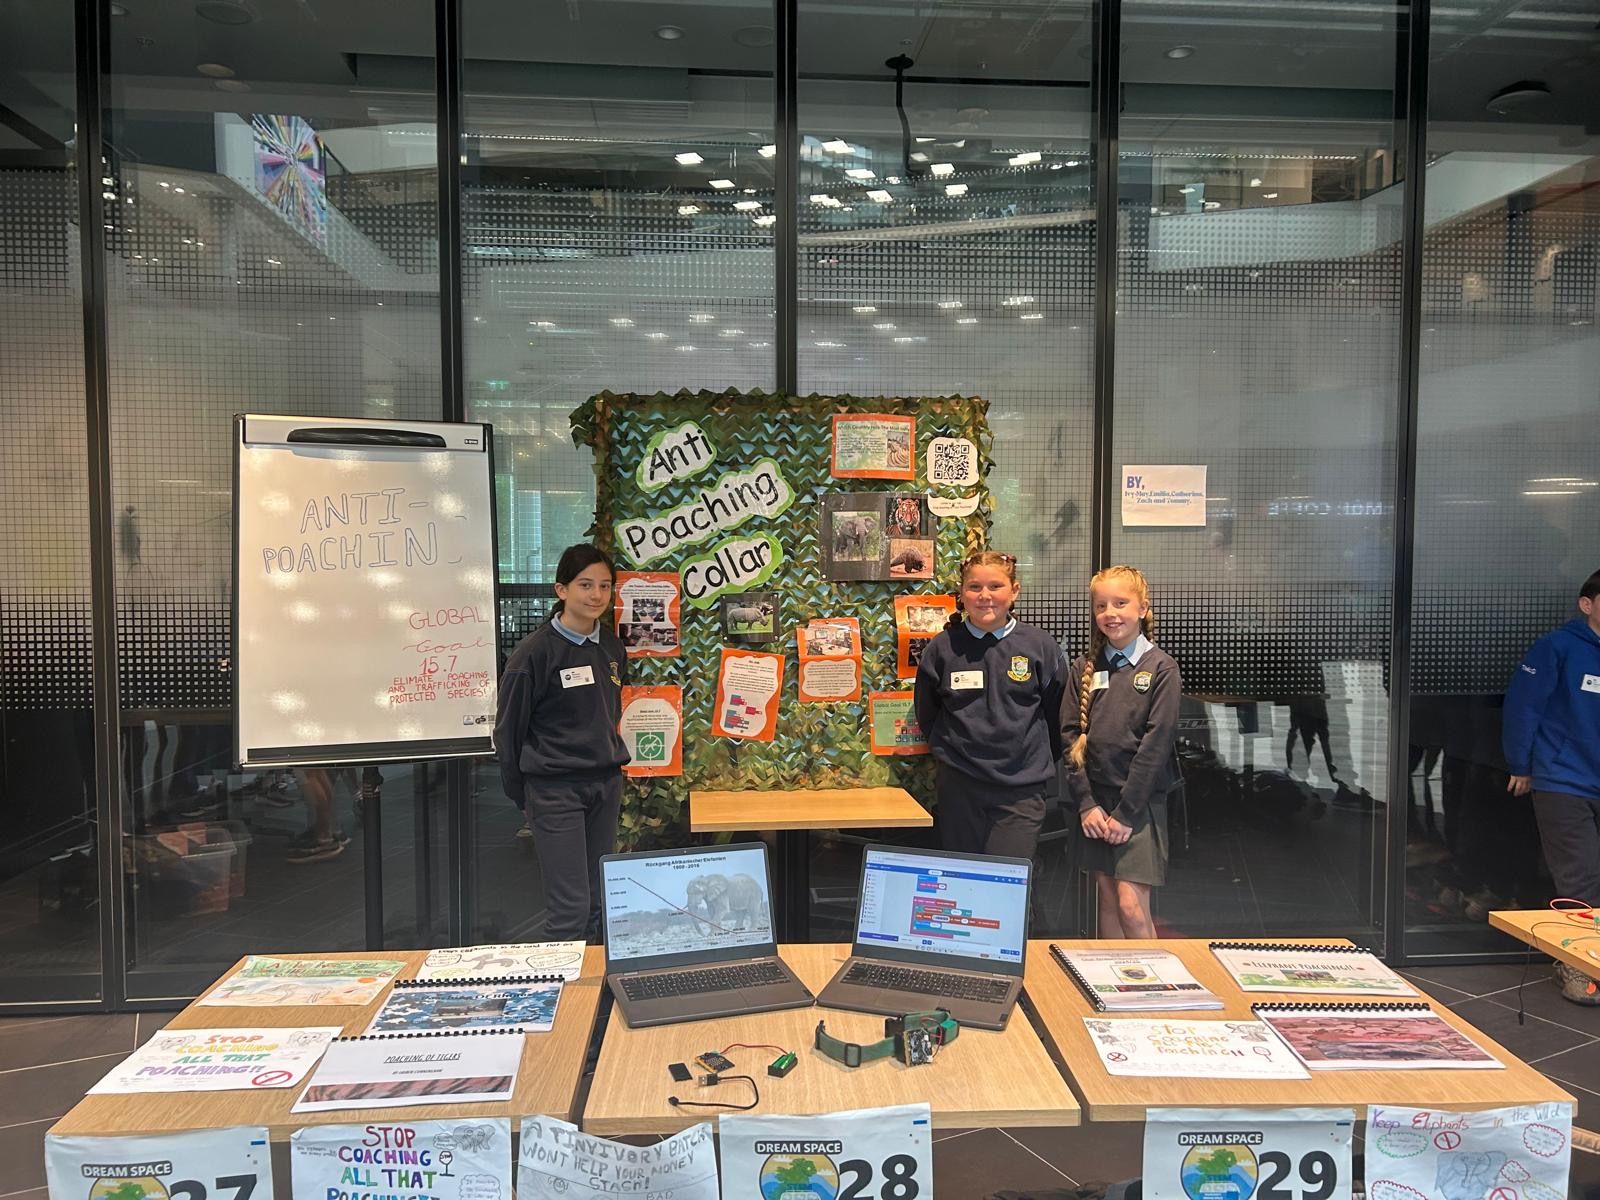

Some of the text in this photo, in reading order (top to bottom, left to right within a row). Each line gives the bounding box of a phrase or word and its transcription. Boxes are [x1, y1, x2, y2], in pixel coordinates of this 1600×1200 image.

[648, 429, 713, 481] Anti
[1127, 476, 1145, 489] BY,
[625, 472, 780, 559] Poaching
[682, 540, 770, 600] Collar
[409, 606, 489, 630] GLOBAL
[418, 655, 459, 676] 15.7
[388, 678, 491, 694] AND TRAFFICKING OF
[394, 671, 489, 686] ELIMATE POACHING
[390, 692, 437, 704] PROTECTED
[204, 1035, 265, 1045] STOP
[172, 1053, 272, 1065] ALL THAT
[384, 1055, 425, 1064] POACHING
[425, 1054, 436, 1062] OF
[1371, 1109, 1402, 1135] Keep
[1412, 1111, 1470, 1134] Elephants
[1512, 1106, 1530, 1123] the
[362, 1125, 417, 1149] STOP
[1180, 1133, 1262, 1145] DREAM SPACE
[338, 1146, 432, 1167] COACHING
[757, 1143, 842, 1154] DREAM SPACE
[83, 1162, 172, 1178] DREAM SPACE
[340, 1165, 438, 1190] ALL THAT
[573, 1154, 609, 1177] HELP
[615, 1165, 646, 1180] YOUR
[839, 1153, 920, 1200] 28
[1256, 1150, 1338, 1200] 29
